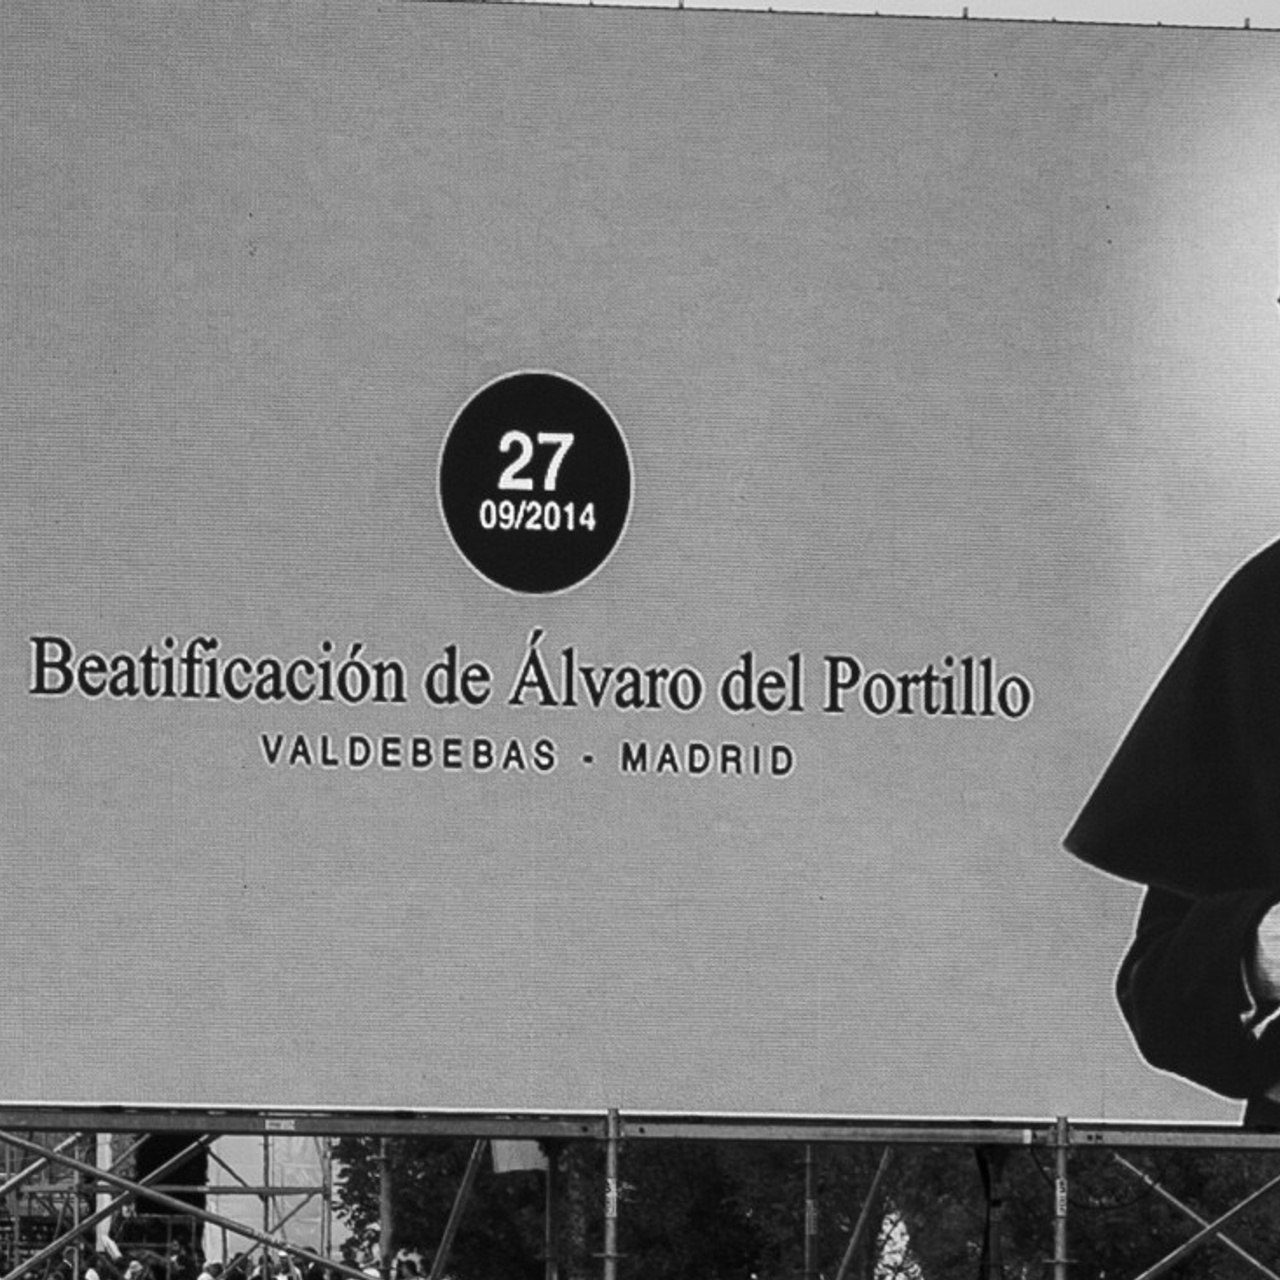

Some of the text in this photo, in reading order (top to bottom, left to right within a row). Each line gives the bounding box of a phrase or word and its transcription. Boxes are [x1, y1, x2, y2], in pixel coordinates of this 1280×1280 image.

[497, 429, 575, 492] 27
[479, 498, 597, 532] 09/2014
[29, 629, 1030, 718] Beatificación de Álvaro del Portillo
[262, 734, 554, 771] VALDEBEBAS
[622, 742, 793, 775] MADRID
